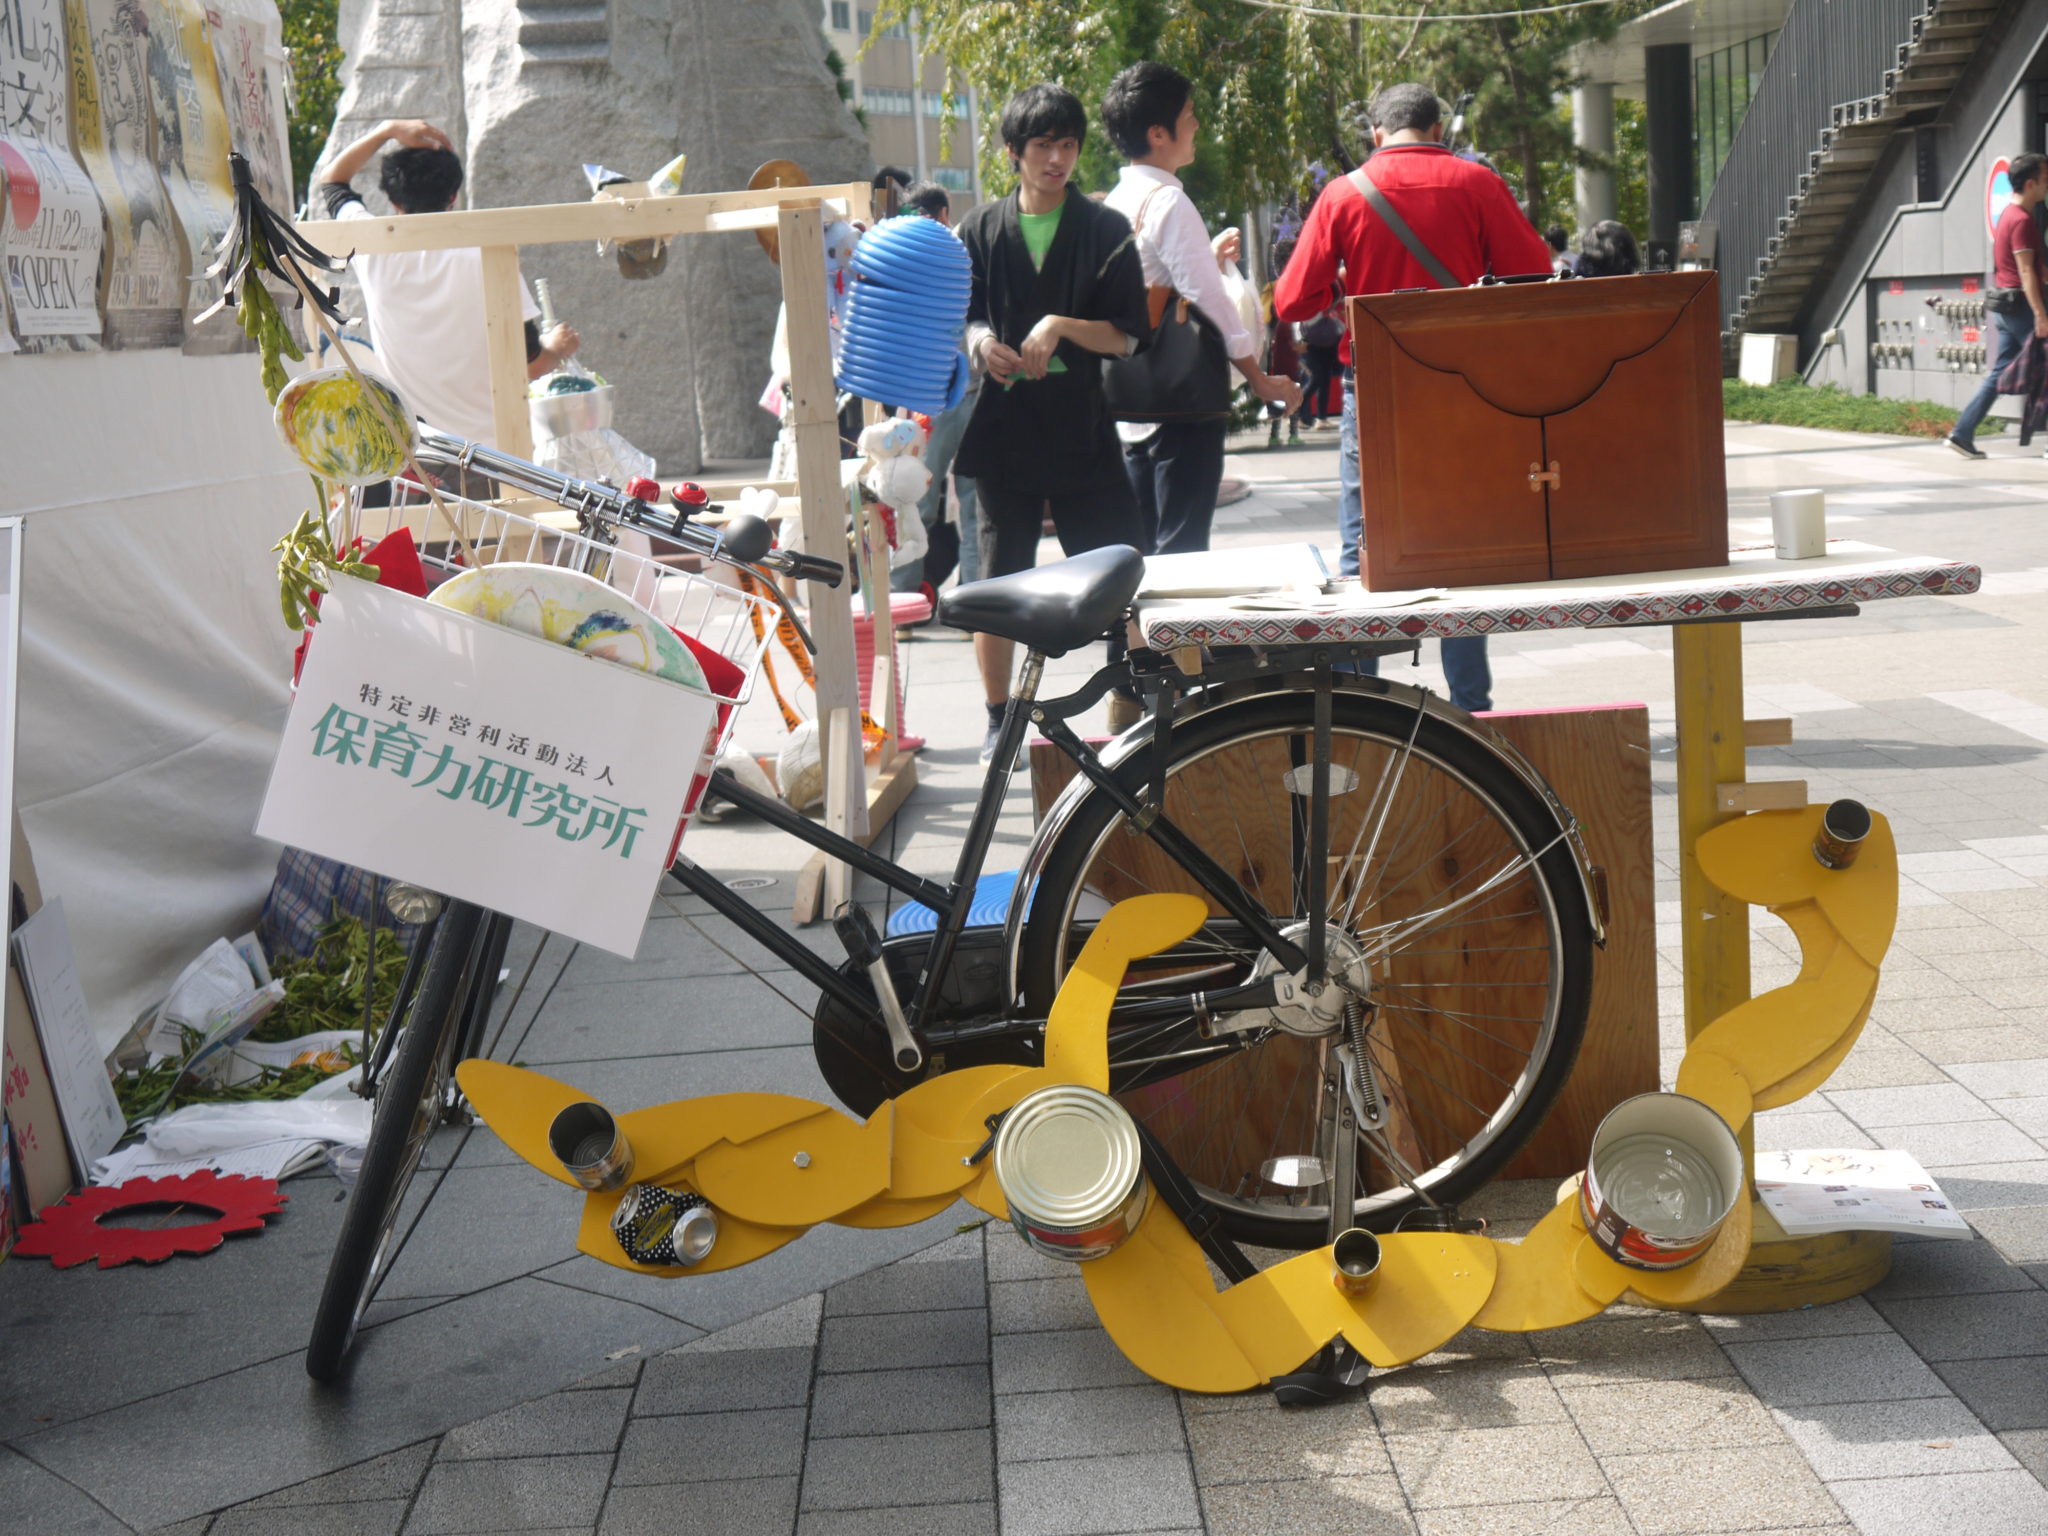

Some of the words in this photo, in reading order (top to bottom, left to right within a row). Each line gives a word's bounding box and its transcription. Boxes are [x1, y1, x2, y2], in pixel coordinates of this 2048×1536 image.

[21, 254, 79, 310] OPEN
[310, 702, 649, 859] 保育力研究所
[359, 683, 615, 787] 特定非営利活動法人
